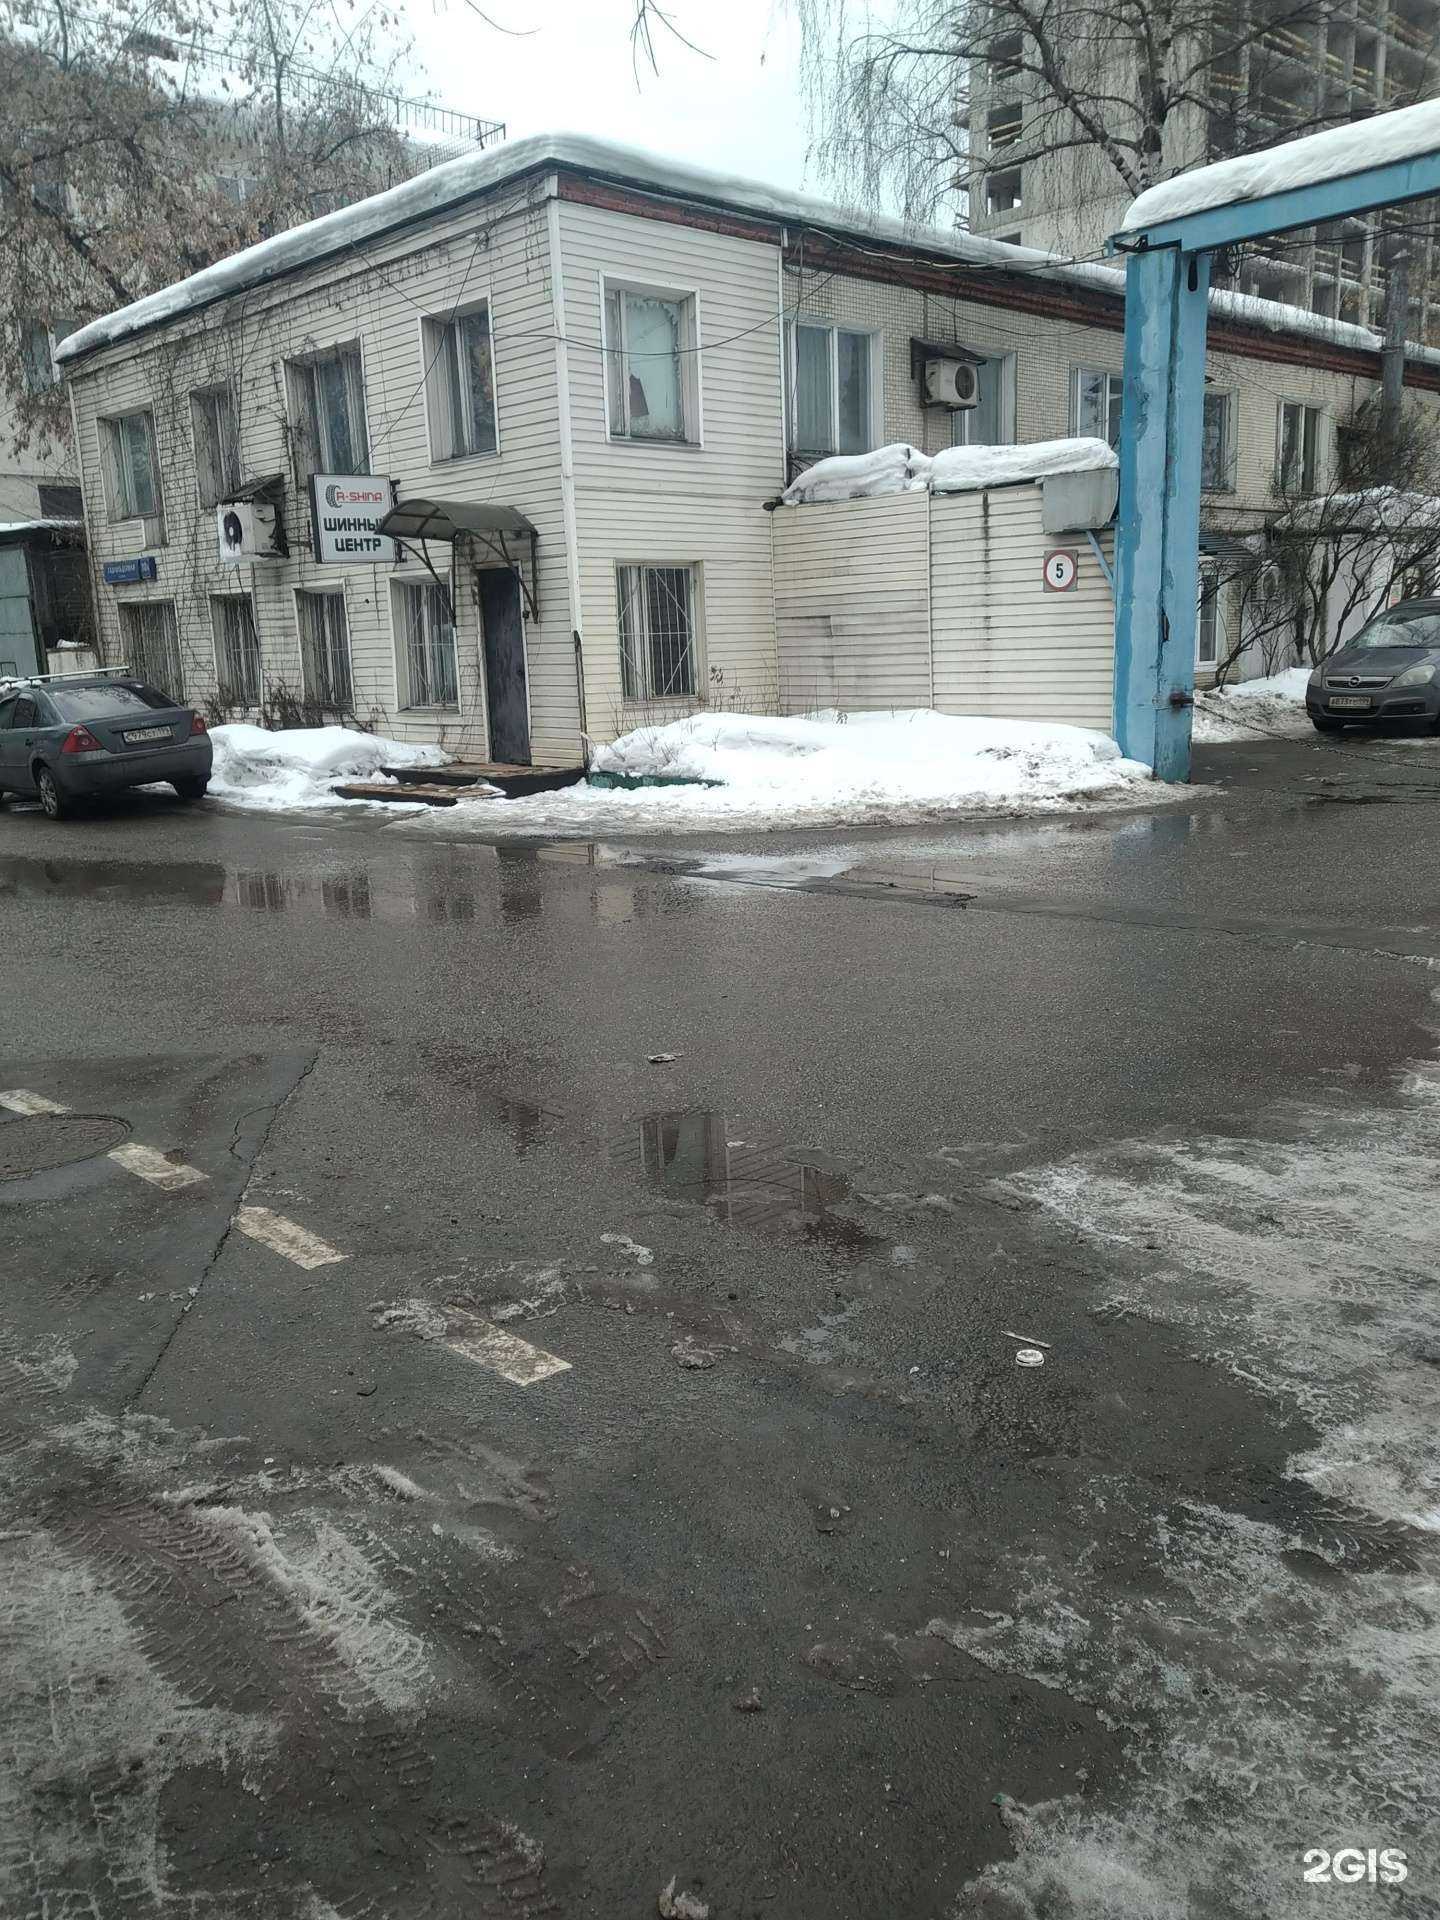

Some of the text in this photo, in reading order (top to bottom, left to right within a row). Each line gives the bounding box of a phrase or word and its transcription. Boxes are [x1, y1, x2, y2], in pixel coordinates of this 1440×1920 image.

[323, 517, 382, 532] ШИННЫ
[334, 538, 381, 552] ЦЕНТР
[1056, 562, 1064, 579] 5
